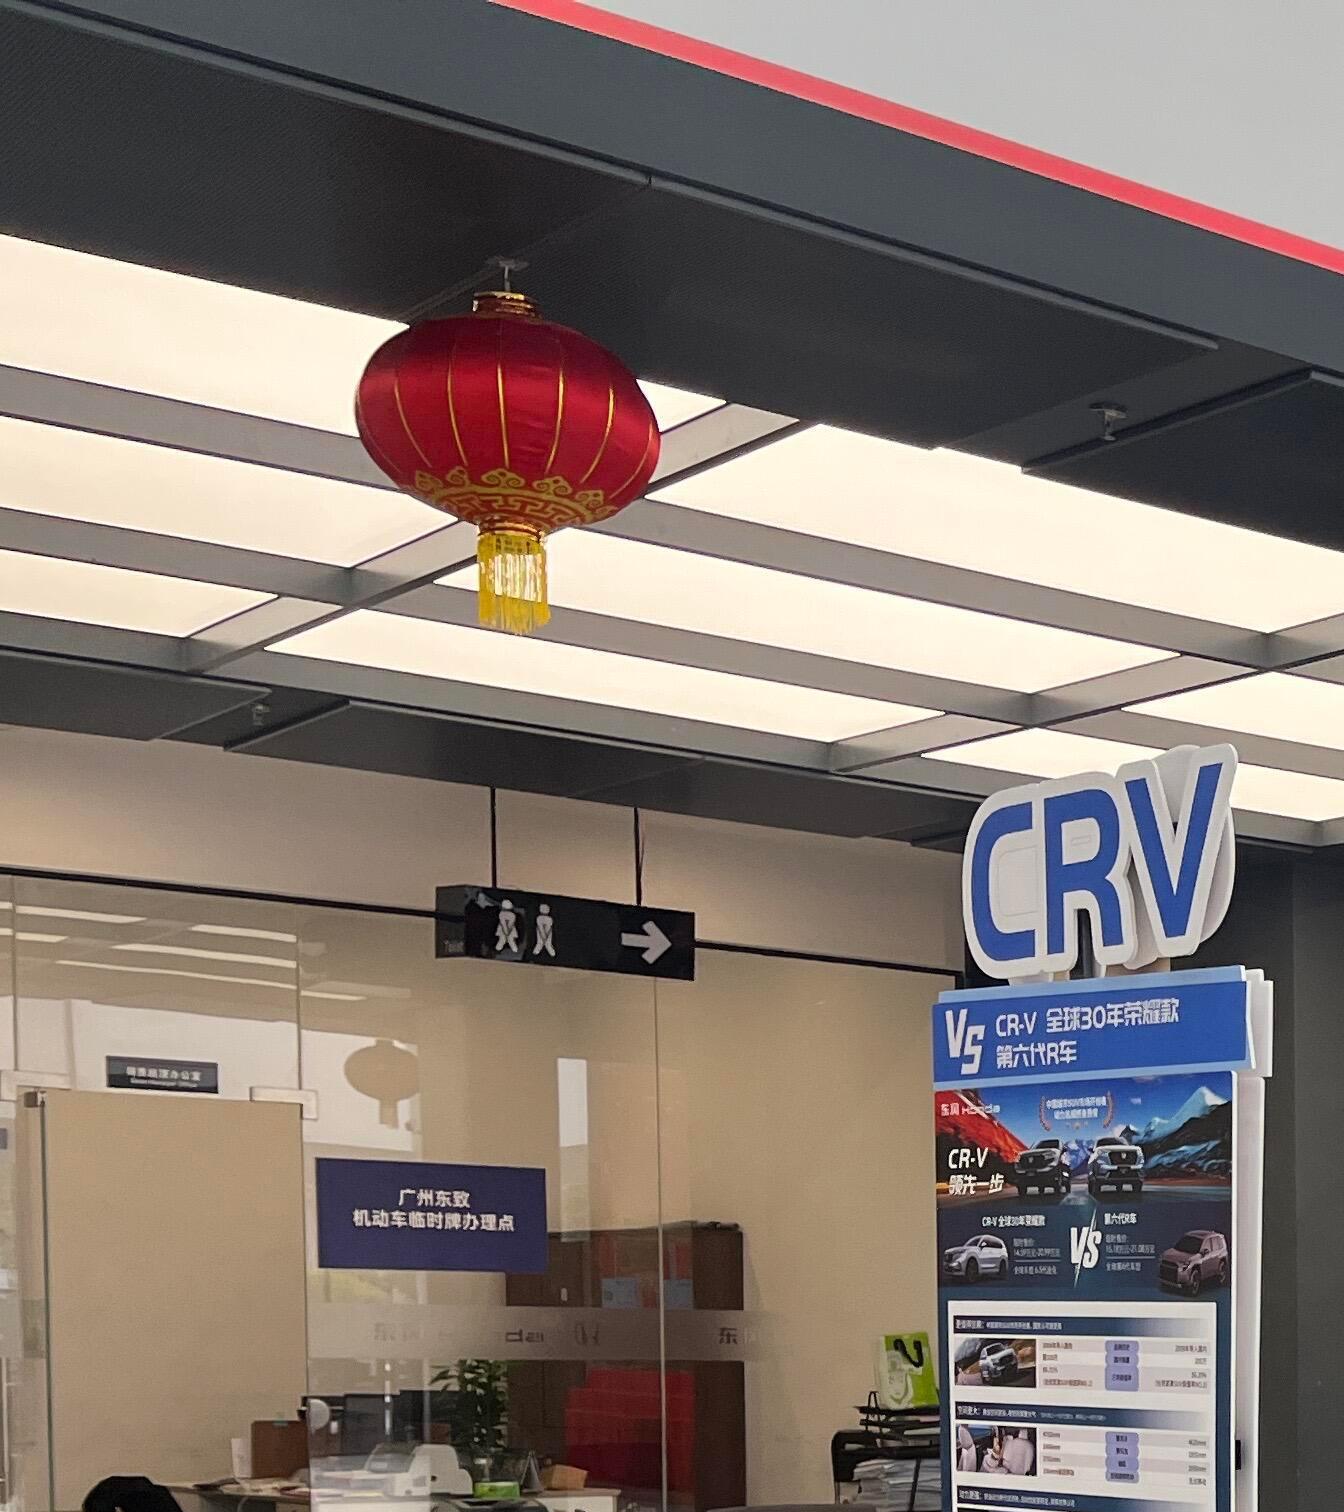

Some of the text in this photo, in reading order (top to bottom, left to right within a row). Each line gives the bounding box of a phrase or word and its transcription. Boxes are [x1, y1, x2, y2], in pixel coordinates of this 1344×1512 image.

[971, 763, 1224, 962] CRV
[995, 998, 1180, 1038] CR-V 全球30年荣耀款
[945, 1009, 985, 1075] VS
[996, 1040, 1077, 1069] 第六代R车
[948, 1147, 989, 1170] CR-V
[398, 1188, 470, 1208] 广州东致
[949, 1174, 1005, 1196] 领先一步
[353, 1209, 515, 1232] 机动车临时牌办理点
[1070, 1227, 1102, 1269] VS
